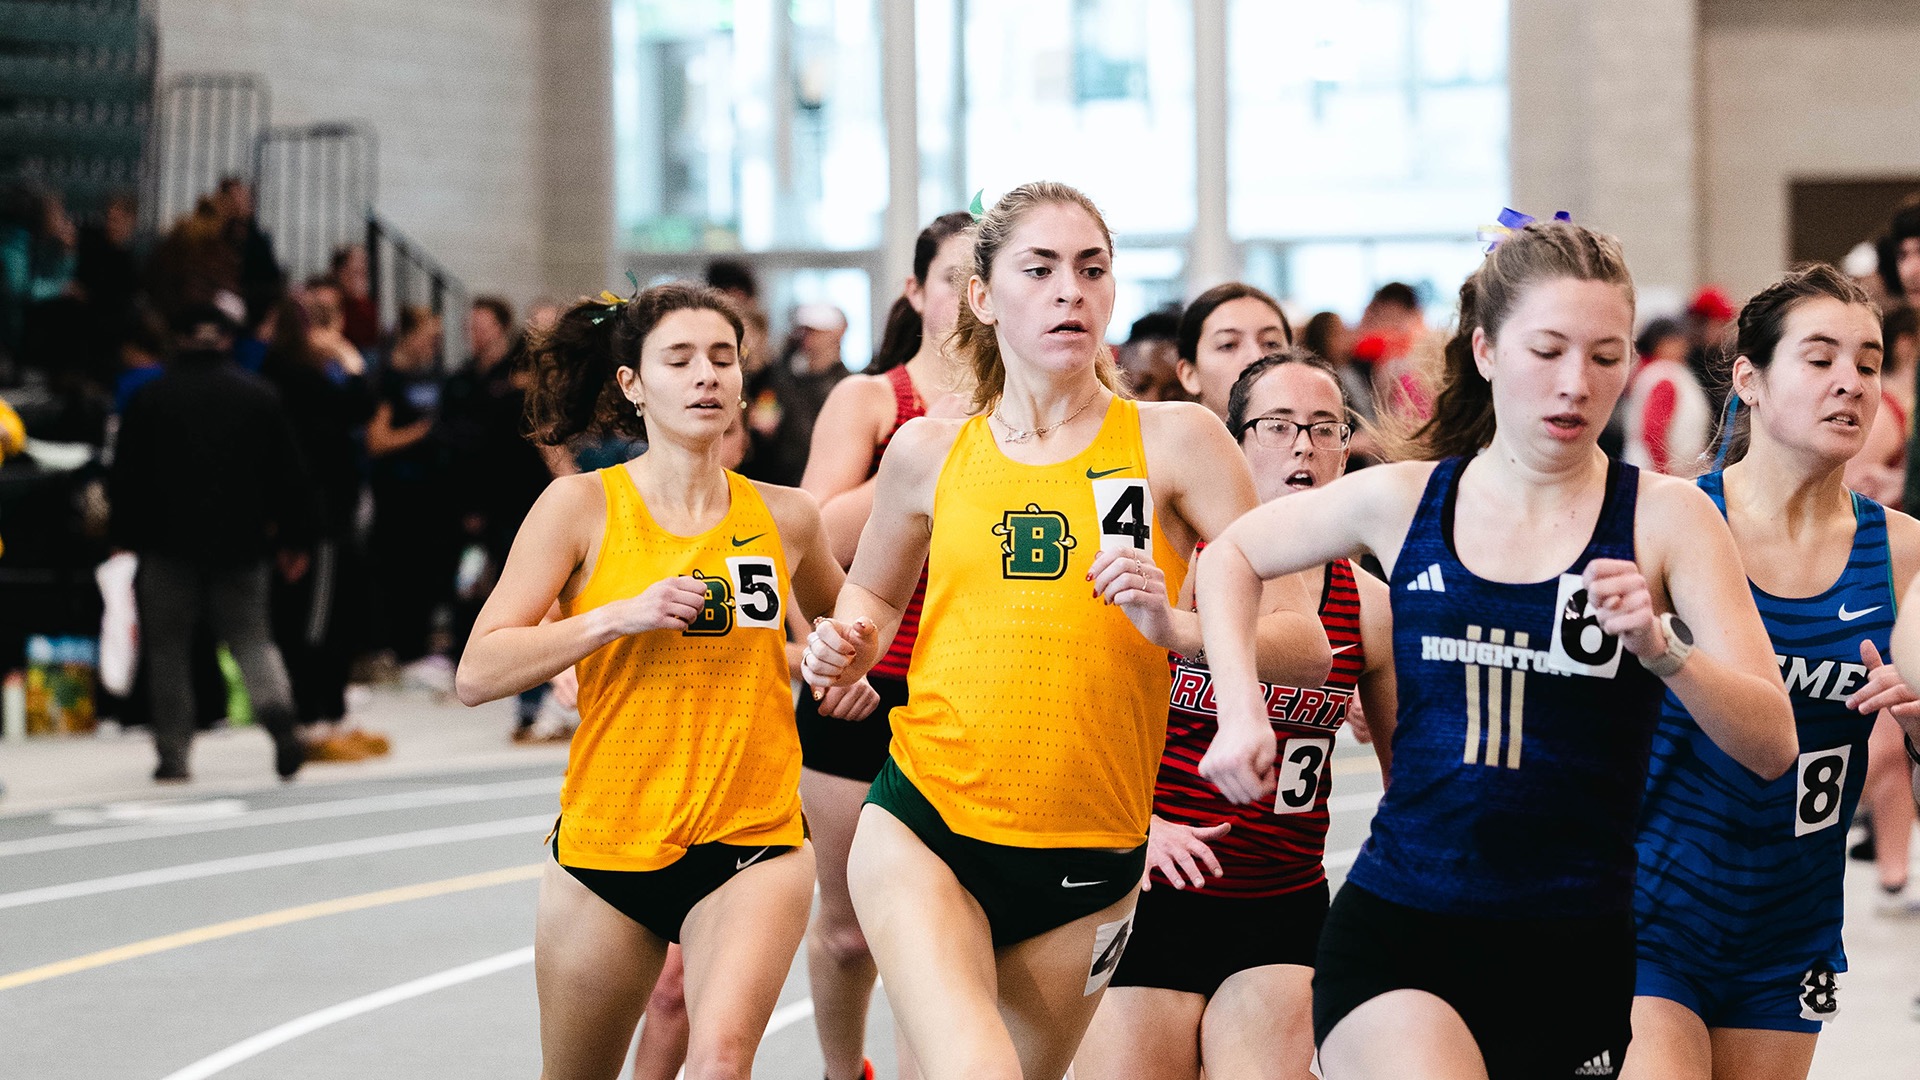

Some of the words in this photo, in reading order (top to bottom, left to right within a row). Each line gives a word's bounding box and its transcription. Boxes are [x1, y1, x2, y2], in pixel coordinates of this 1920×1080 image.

[1000, 507, 1070, 580] B
[1102, 485, 1150, 550] 4
[738, 563, 780, 621] 5
[1420, 636, 1572, 677] HOUGHTO
[1560, 588, 1620, 666] 6
[1776, 654, 1867, 702] ME
[1281, 744, 1324, 808] 3
[1798, 754, 1844, 825] 8
